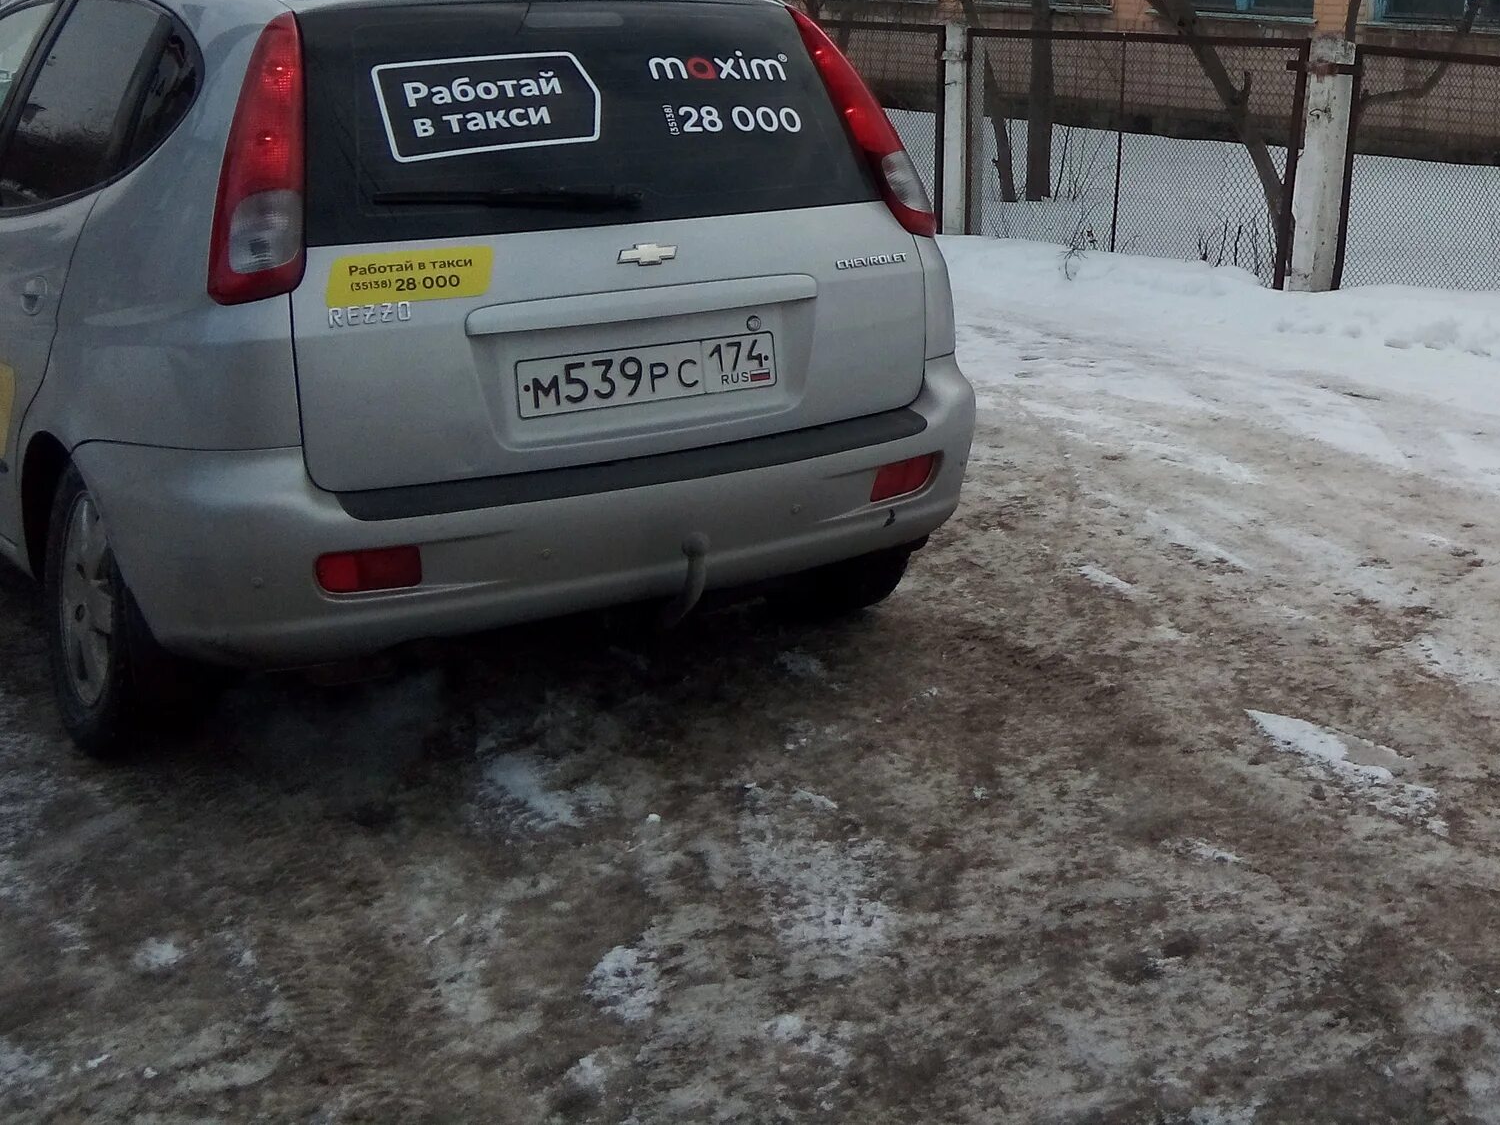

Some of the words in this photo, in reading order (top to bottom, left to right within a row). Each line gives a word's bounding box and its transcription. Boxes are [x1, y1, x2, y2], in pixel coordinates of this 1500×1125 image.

[403, 71, 562, 108] Работай
[413, 118, 435, 138] в
[442, 105, 551, 134] такси
[678, 105, 724, 133] 28
[731, 106, 802, 133] 000
[349, 260, 414, 276] Работай
[418, 262, 426, 270] в
[429, 258, 473, 270] такси
[836, 252, 908, 270] CHEVROLET
[350, 278, 392, 292] (35138)
[395, 277, 417, 292] 28
[422, 274, 461, 290] 000
[328, 301, 412, 328] REZZO
[708, 339, 764, 372] 174
[721, 370, 750, 385] RUS
